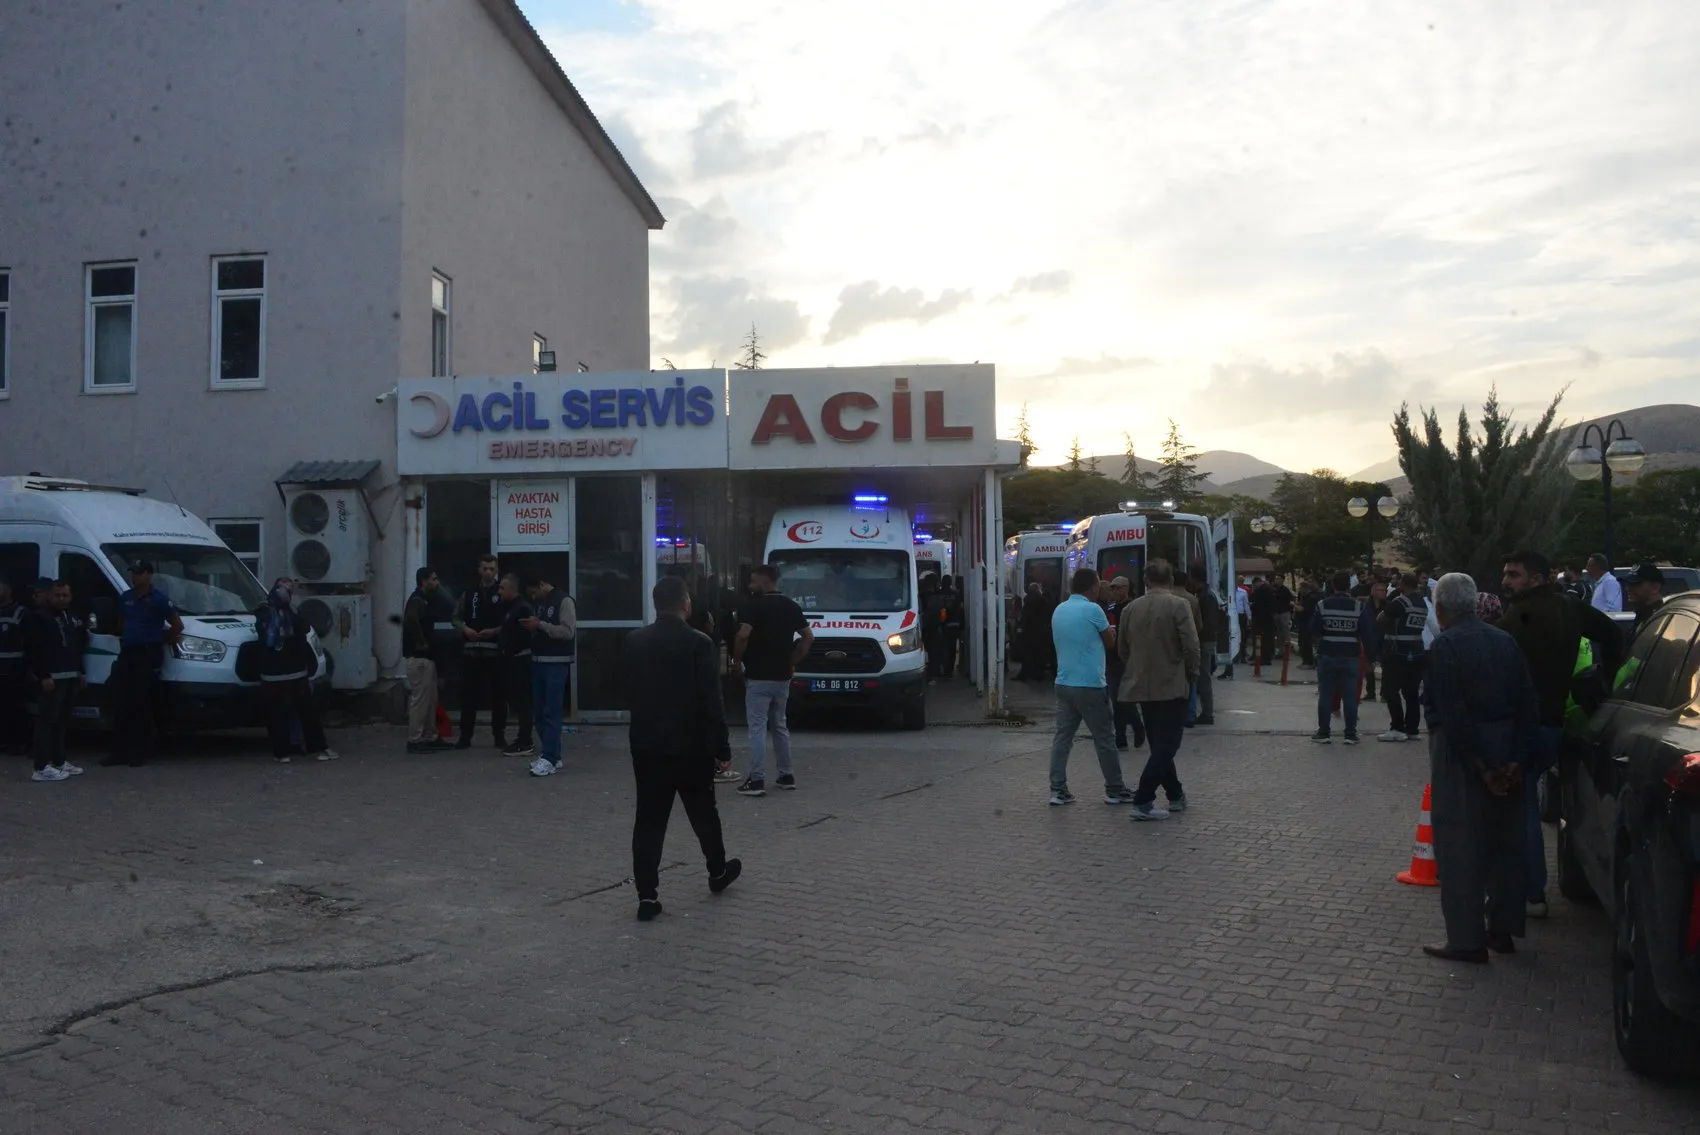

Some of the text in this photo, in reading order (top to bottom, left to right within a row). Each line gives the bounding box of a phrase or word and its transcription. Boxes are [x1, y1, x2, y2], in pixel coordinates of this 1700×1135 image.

[452, 377, 714, 432] ACİL SERVİS
[751, 377, 974, 444] ACİL
[488, 437, 638, 460] EMERGENCY
[507, 492, 559, 504] AYAKTAN
[515, 507, 552, 519] HASTA
[517, 520, 550, 536] GİRİŞİ
[802, 525, 823, 535] 112
[1106, 528, 1145, 542] AMBU
[816, 680, 826, 689] 46
[844, 680, 859, 689] 812
